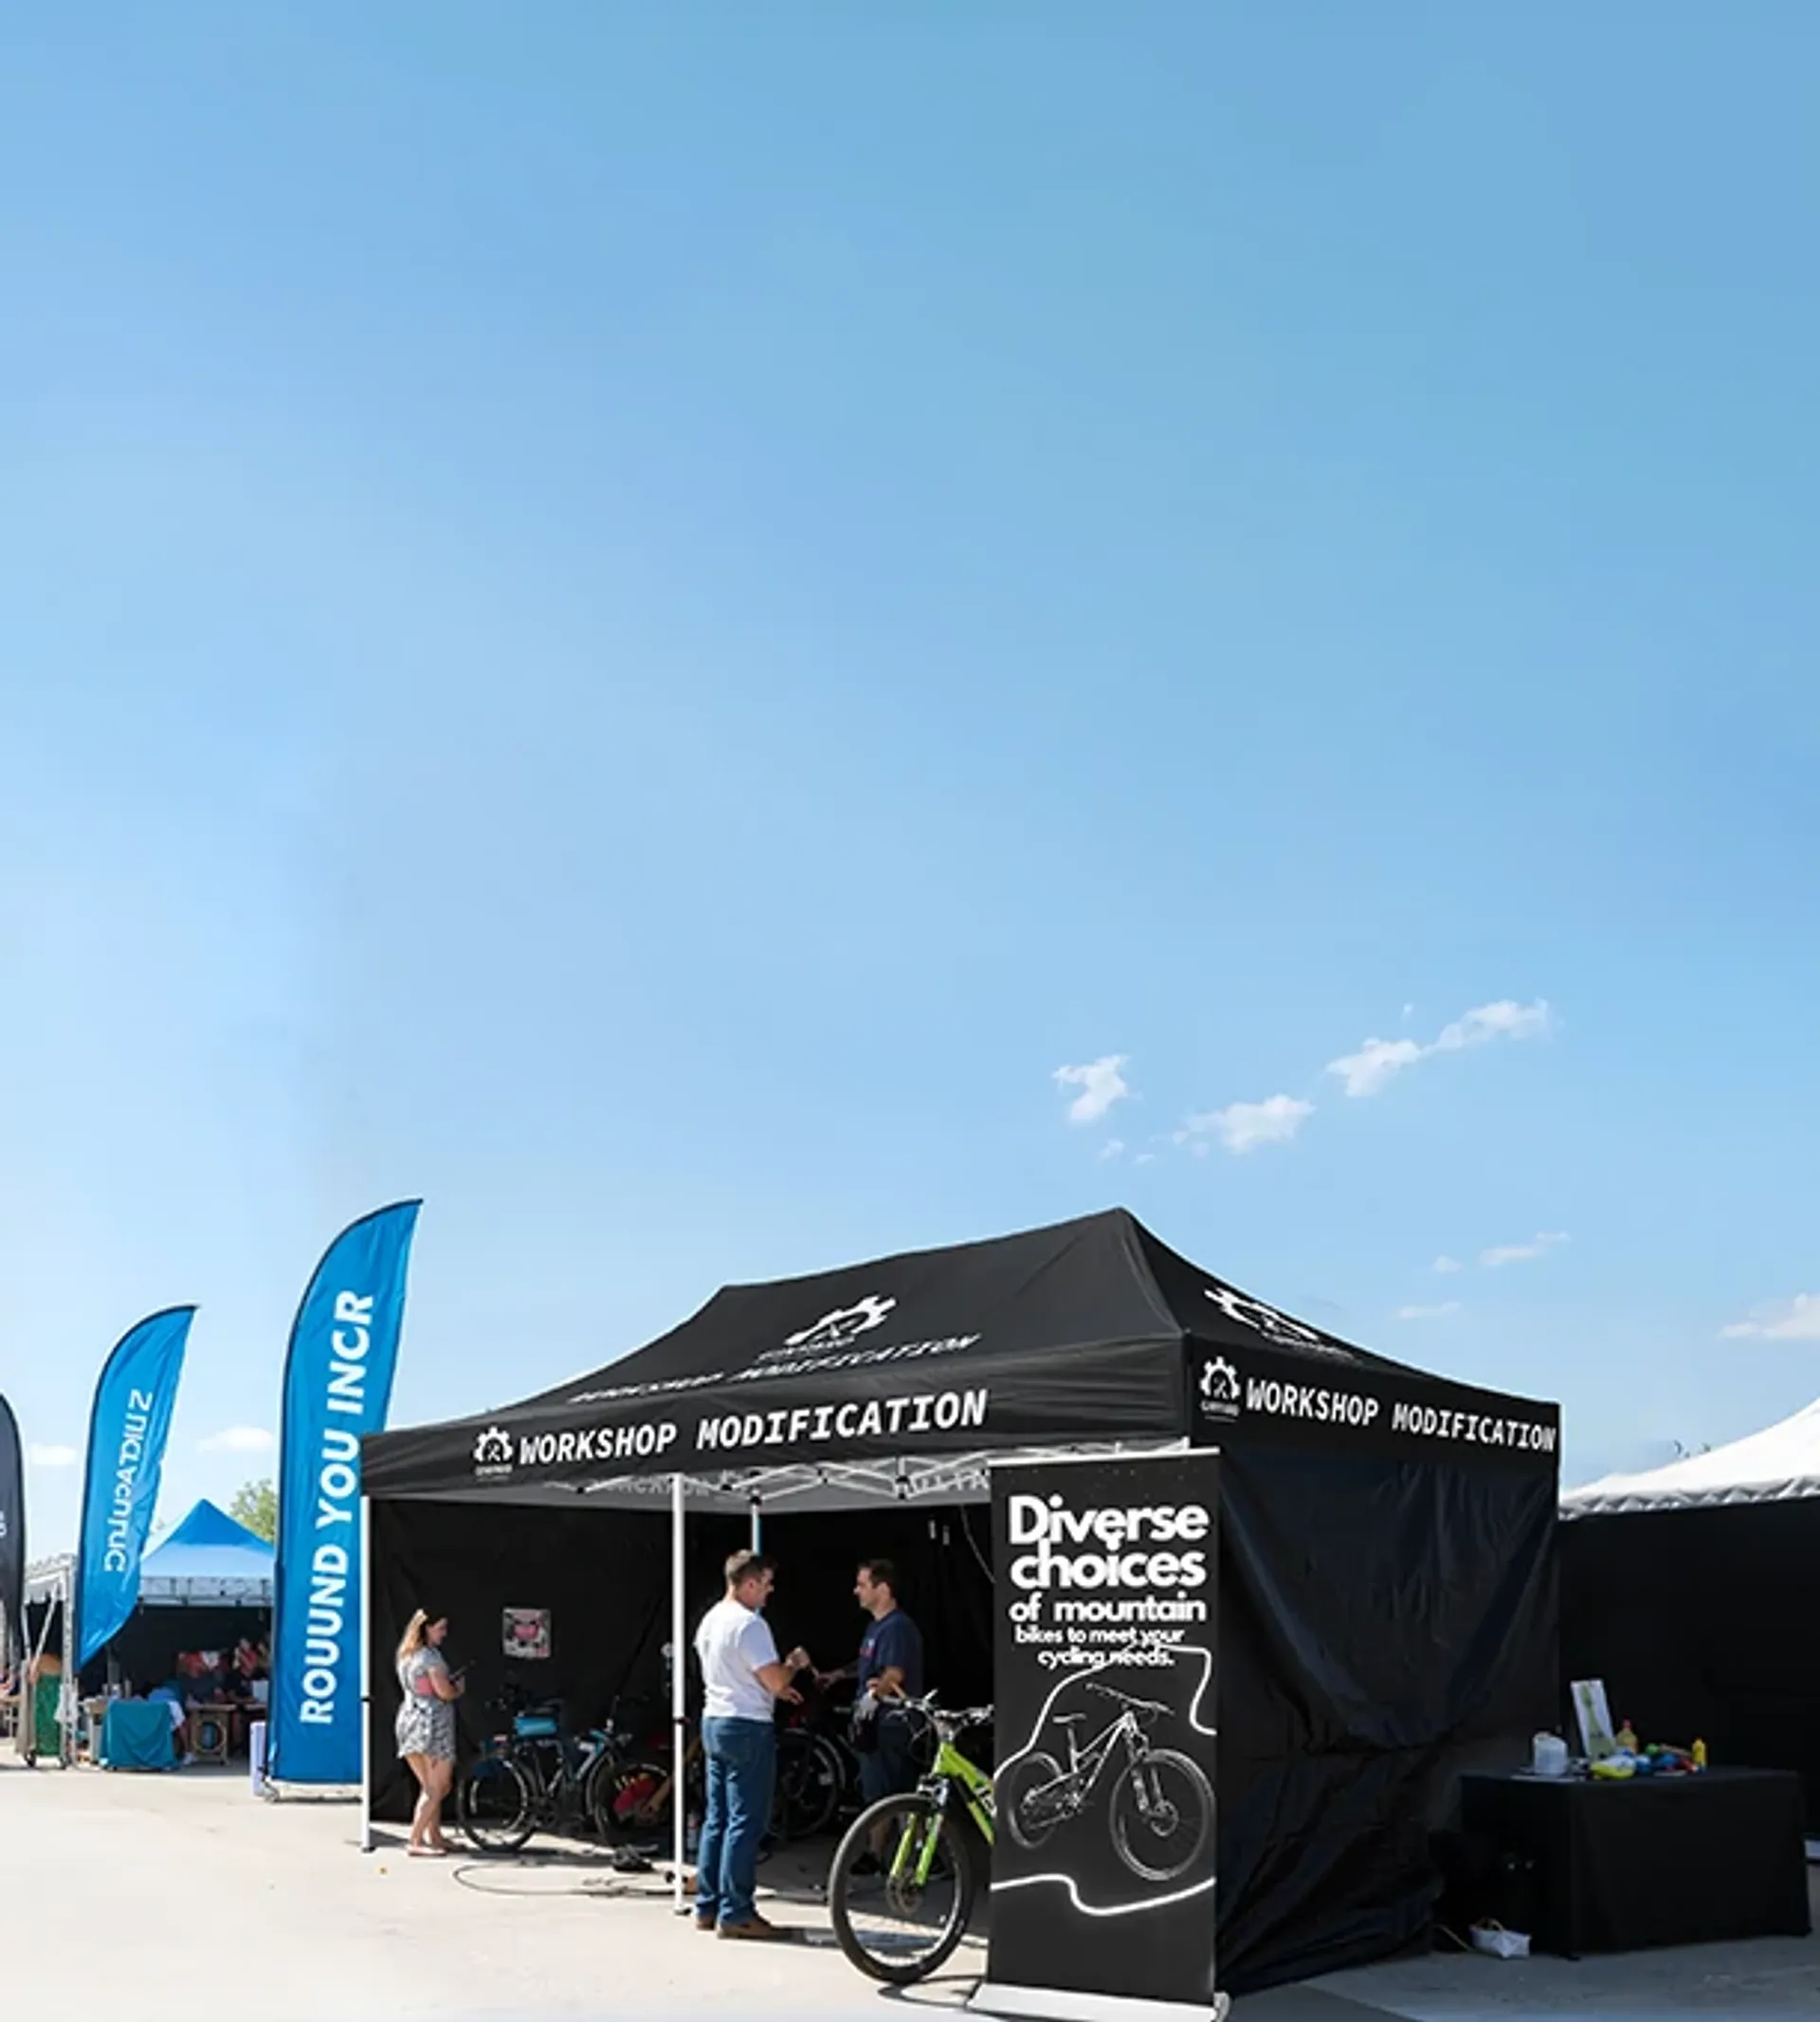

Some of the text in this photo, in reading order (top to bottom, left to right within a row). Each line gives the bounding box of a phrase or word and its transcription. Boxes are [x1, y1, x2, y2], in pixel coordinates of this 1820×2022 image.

[519, 1423, 677, 1466] WORKSHOP
[696, 1388, 988, 1450] MODIFICATION
[1247, 1377, 1556, 1452] WORKSHOP MODIFICATION
[300, 1290, 373, 1723] ROUUND YOU INCR
[1009, 1494, 1210, 1544] Diverse
[1010, 1537, 1207, 1589] choices
[1009, 1590, 1207, 1622] of mountain
[1015, 1624, 1186, 1649] bikes to meet your
[1037, 1646, 1105, 1669] cycling
